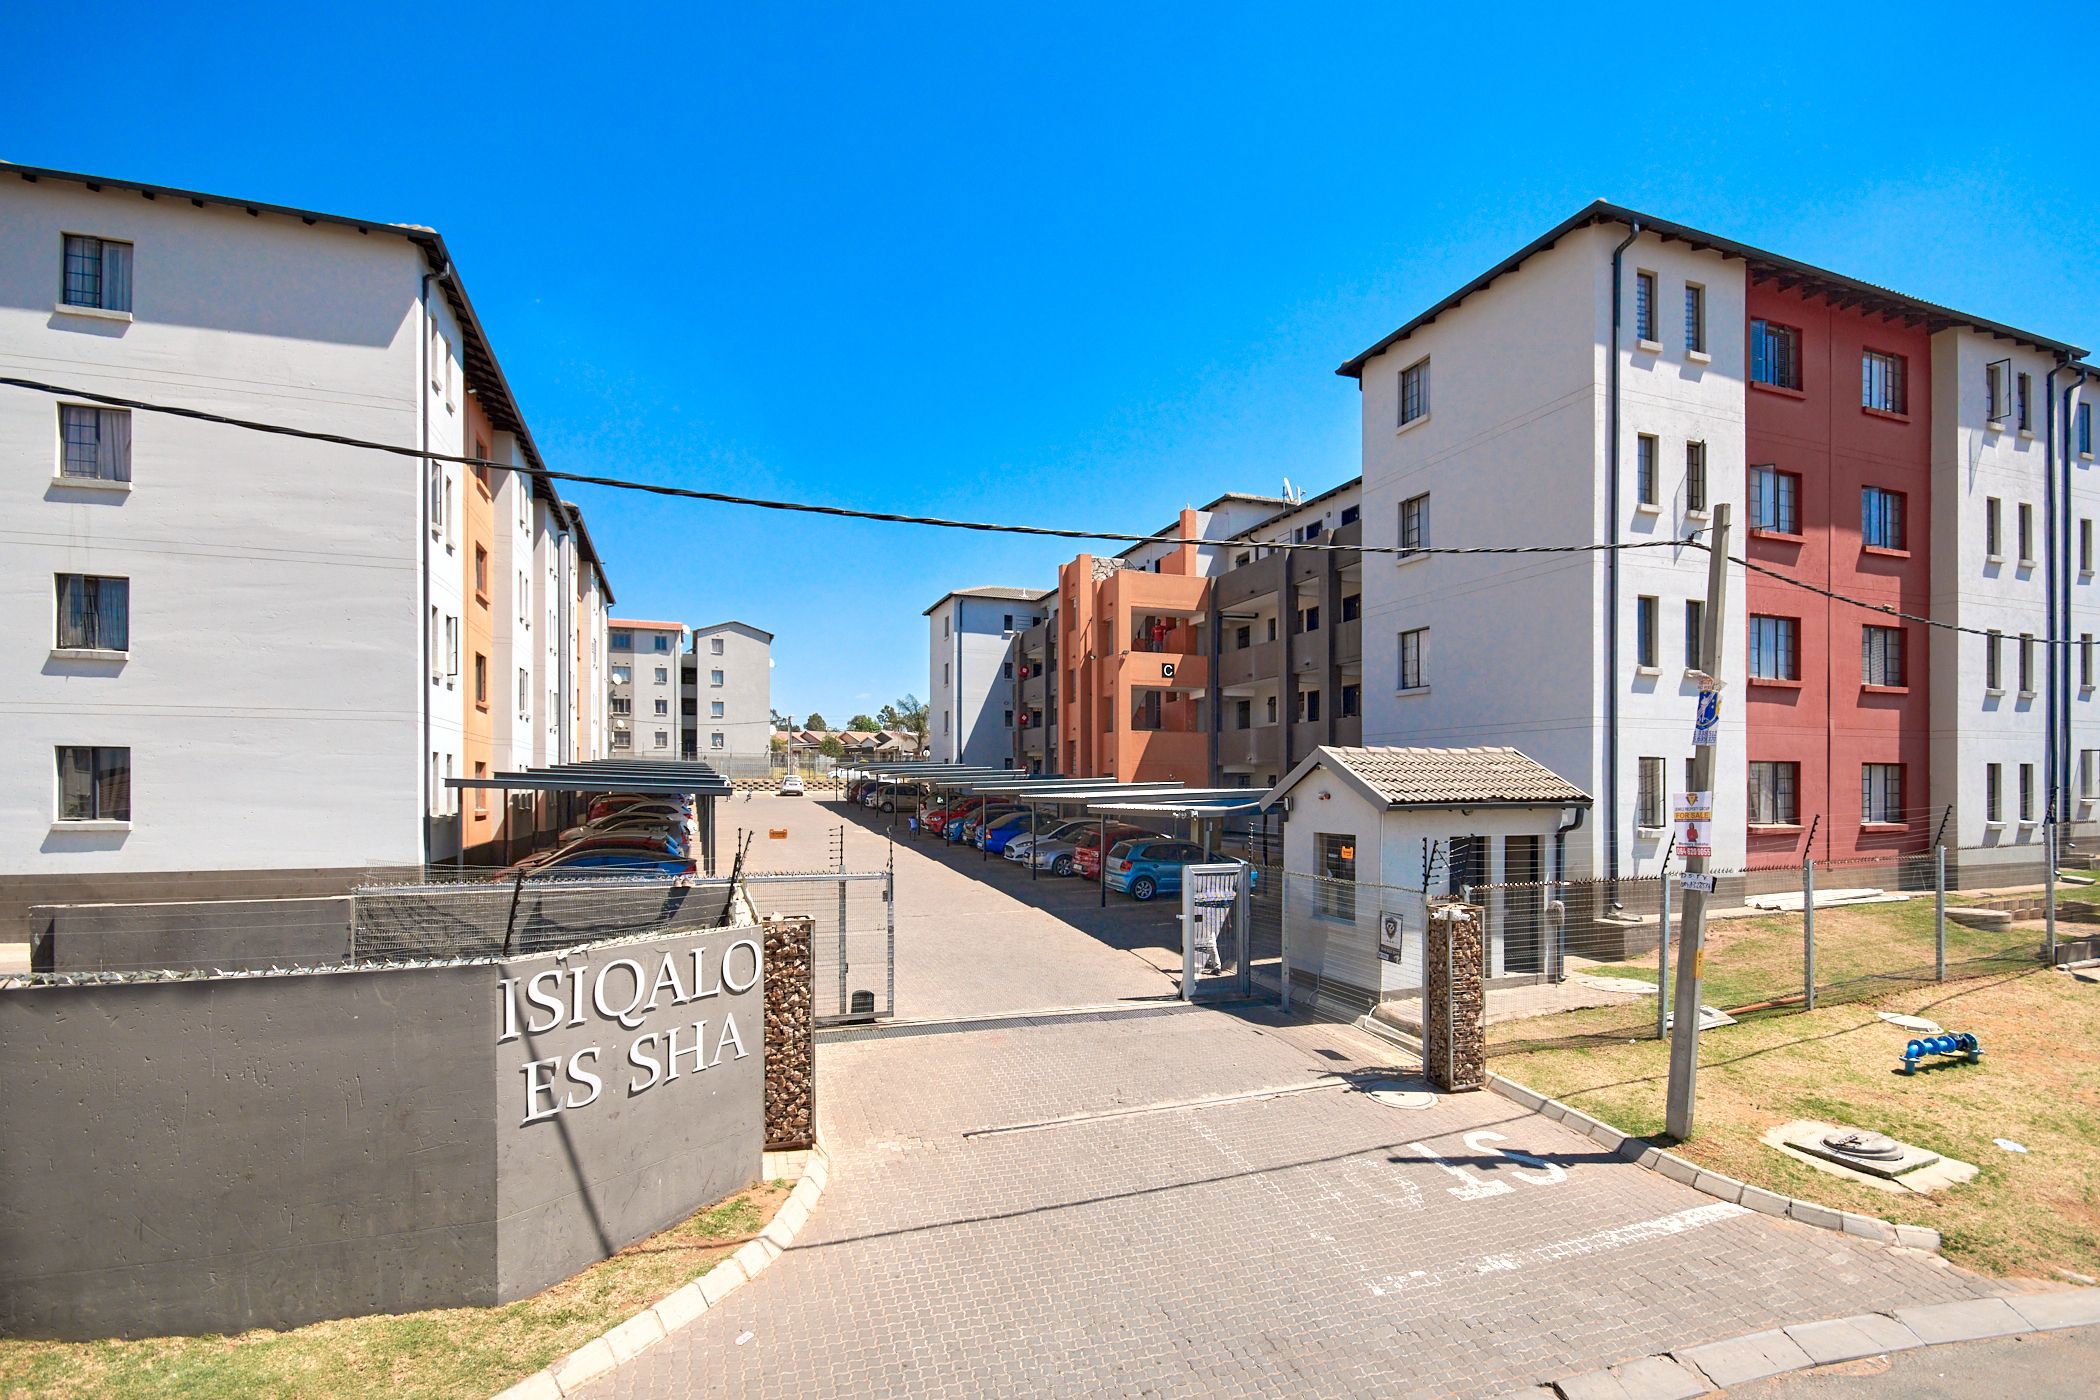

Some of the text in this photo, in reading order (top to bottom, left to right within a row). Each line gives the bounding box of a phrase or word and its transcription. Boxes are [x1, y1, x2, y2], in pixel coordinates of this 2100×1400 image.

[1163, 664, 1173, 676] C
[500, 939, 763, 1041] ISIQALO
[521, 1012, 750, 1125] ES SHA
